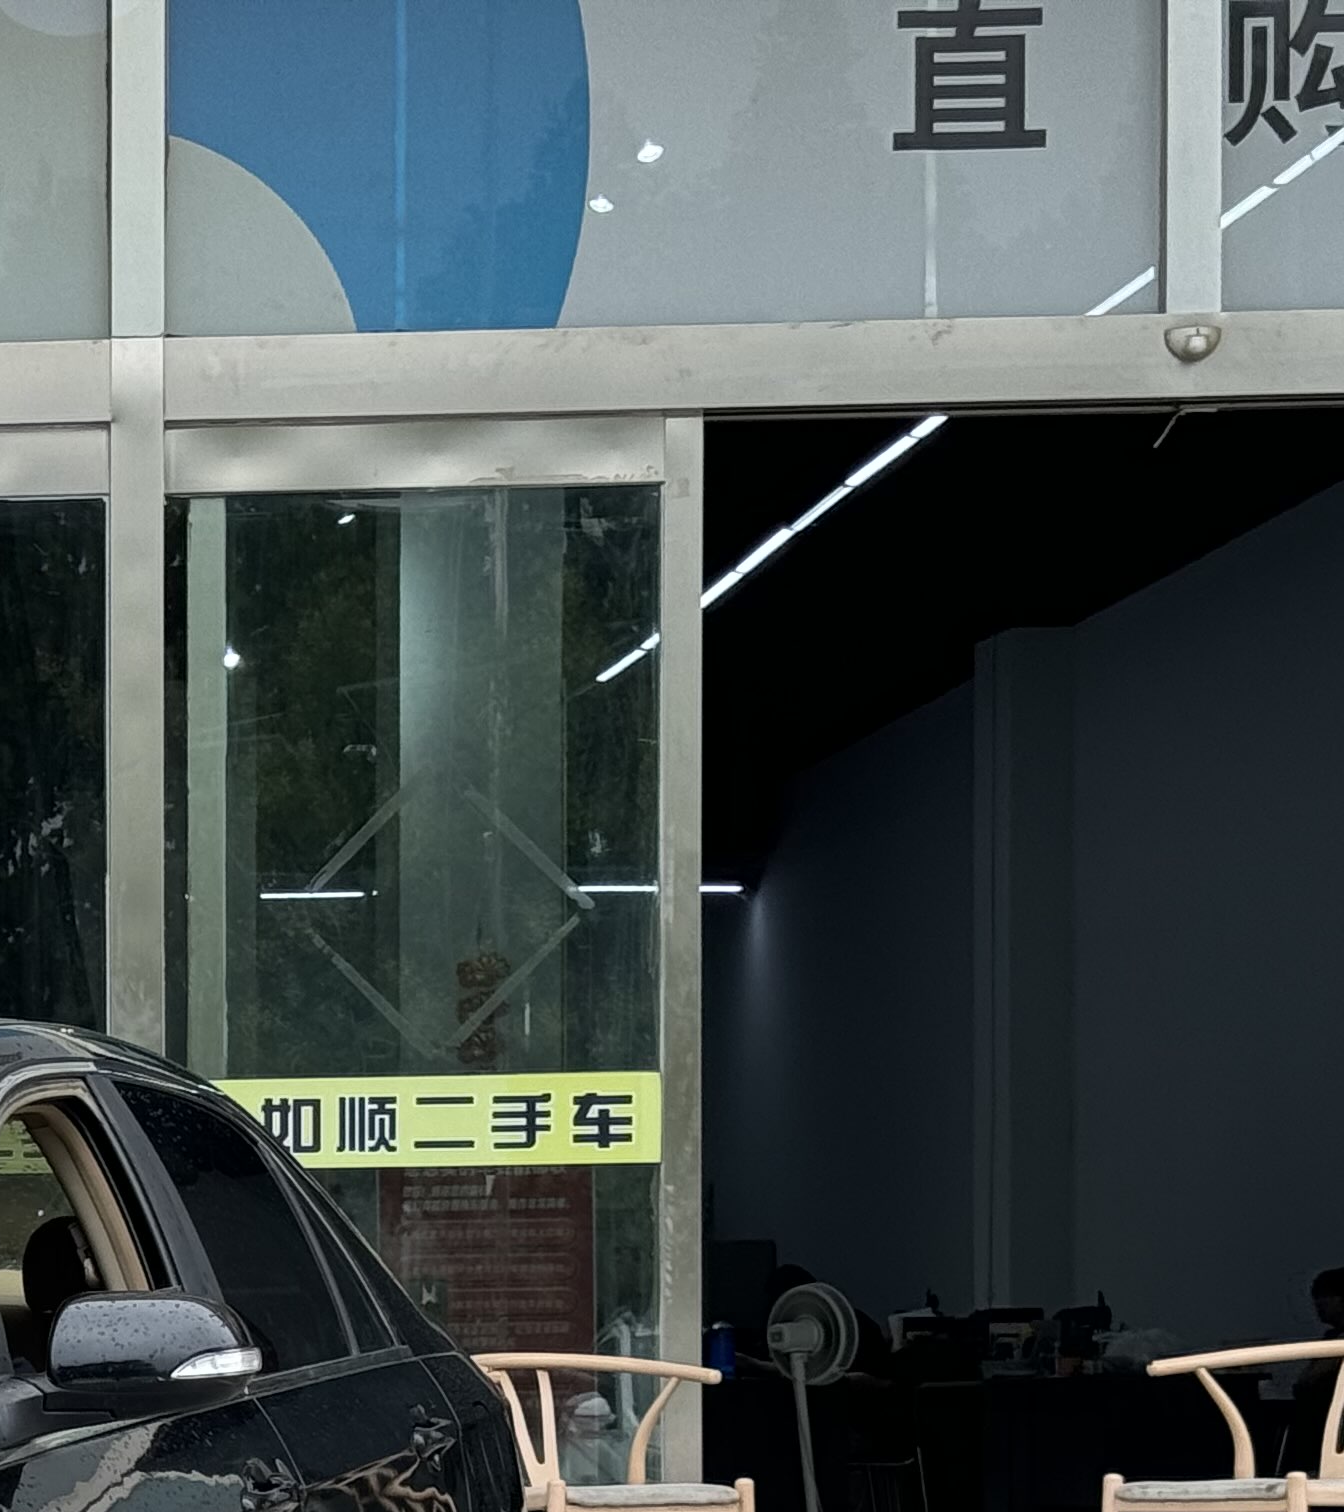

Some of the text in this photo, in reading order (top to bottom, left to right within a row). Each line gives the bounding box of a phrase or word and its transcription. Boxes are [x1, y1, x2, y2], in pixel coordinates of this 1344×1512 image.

[261, 1092, 633, 1153] 如顺二手车
